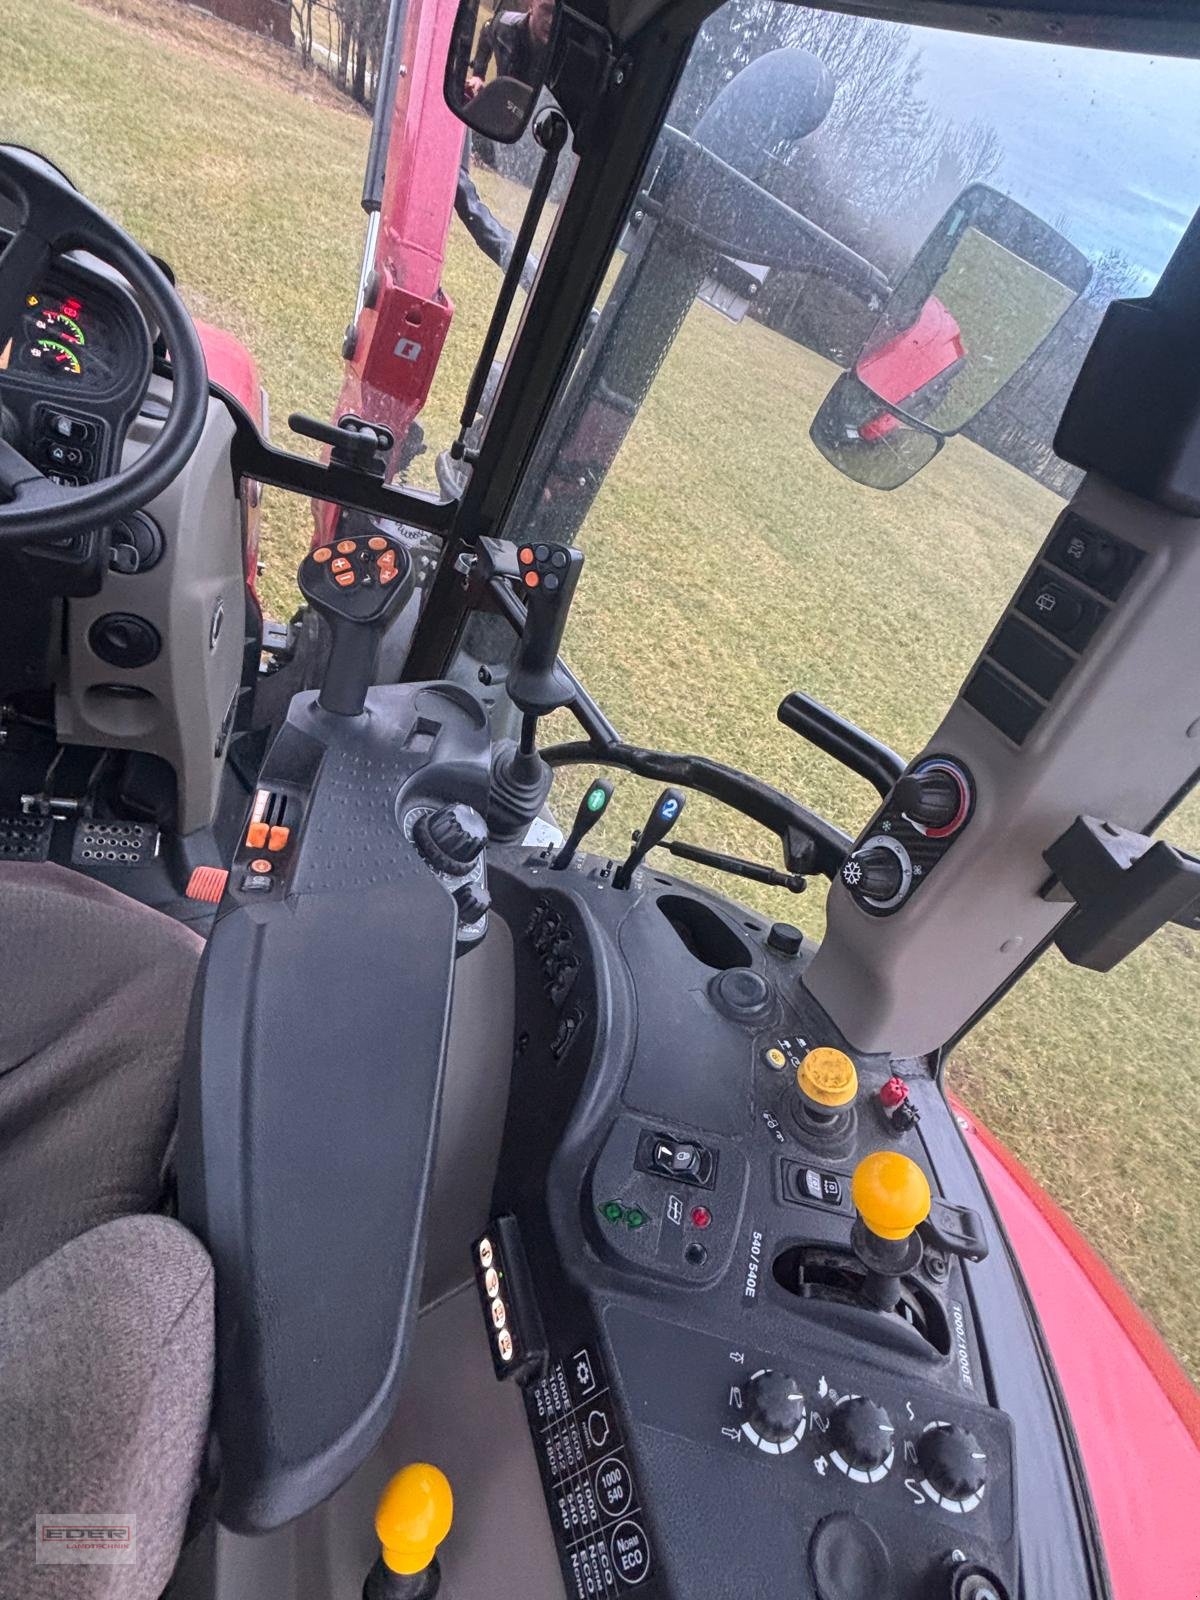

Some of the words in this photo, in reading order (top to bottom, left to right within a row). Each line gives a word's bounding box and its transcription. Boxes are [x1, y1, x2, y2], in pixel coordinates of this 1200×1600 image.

[662, 799, 678, 818] 2
[745, 1232, 761, 1297] 540/540E
[953, 1306, 972, 1386] 1000/1000E
[535, 1389, 545, 1416] 540
[550, 1376, 561, 1410] 1000
[602, 1469, 621, 1488] 1000
[607, 1485, 623, 1504] 540
[559, 1498, 570, 1529] 540
[567, 1493, 578, 1525] 540
[575, 1485, 588, 1525] 1000
[583, 1479, 597, 1520] 1000
[580, 1550, 594, 1593] ECO
[597, 1541, 613, 1585] ECO
[621, 1549, 643, 1571] ECO
